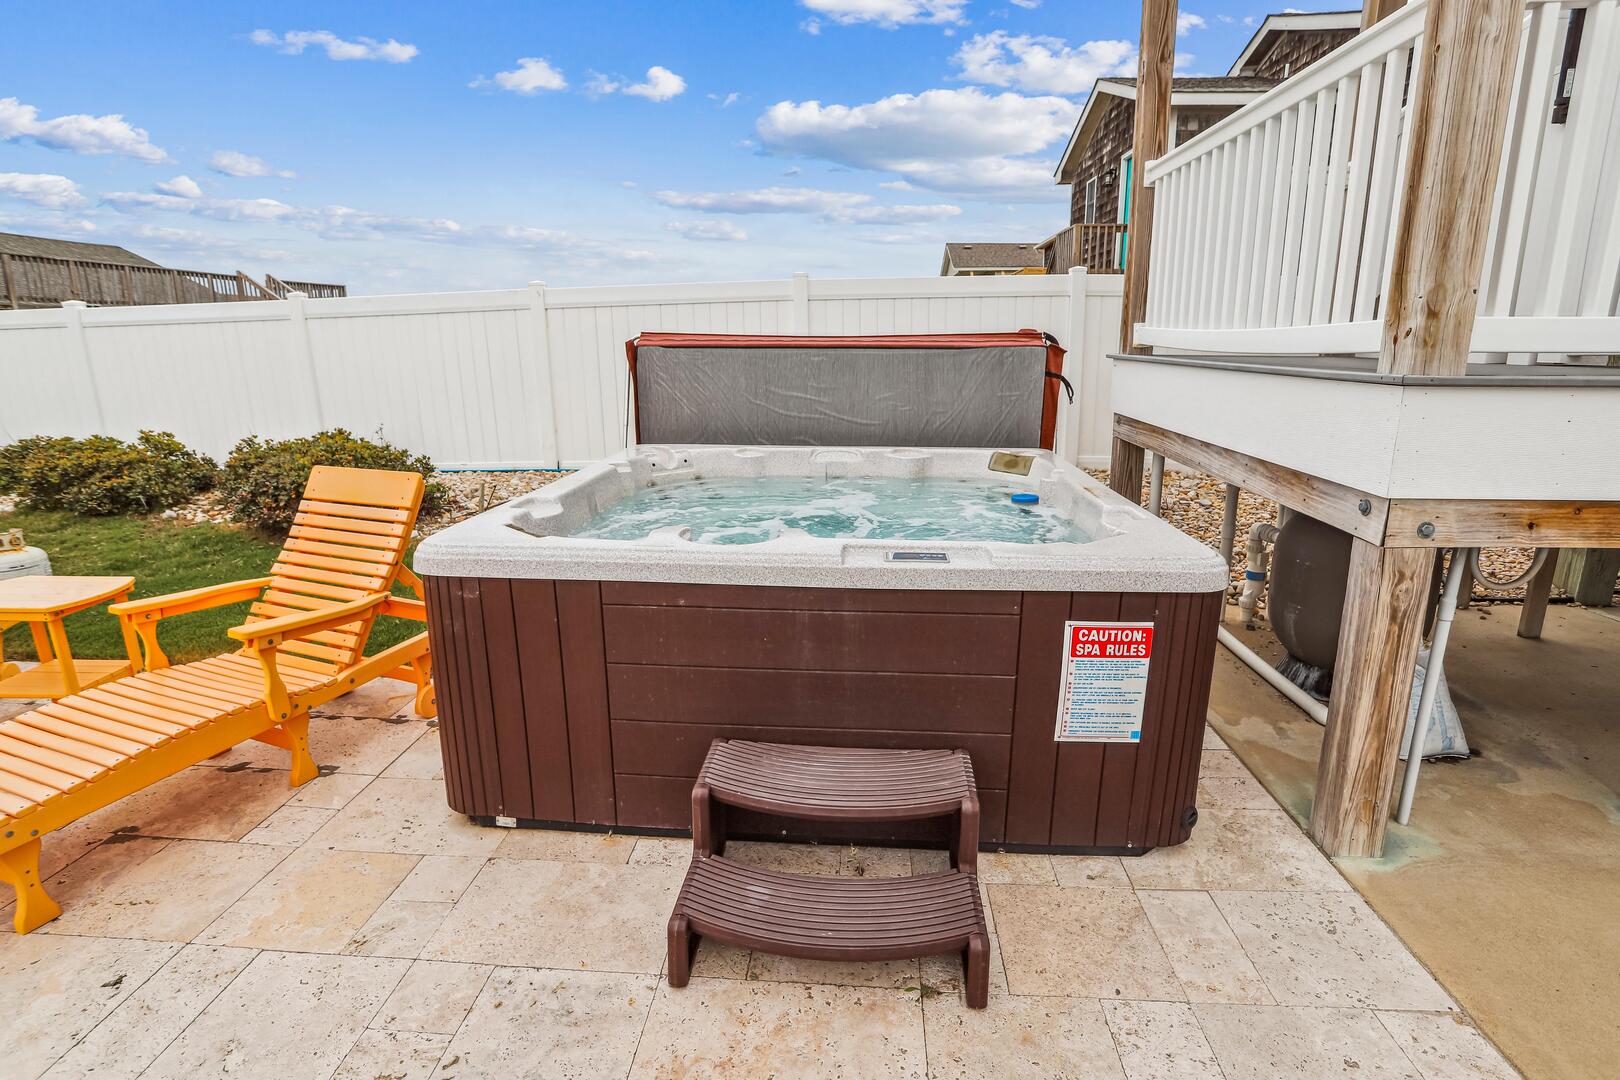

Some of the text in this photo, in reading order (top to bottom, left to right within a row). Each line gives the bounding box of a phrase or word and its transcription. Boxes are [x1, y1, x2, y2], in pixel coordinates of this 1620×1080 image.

[1078, 629, 1146, 642] CAUTION:
[1075, 644, 1146, 656] SPA RULES
